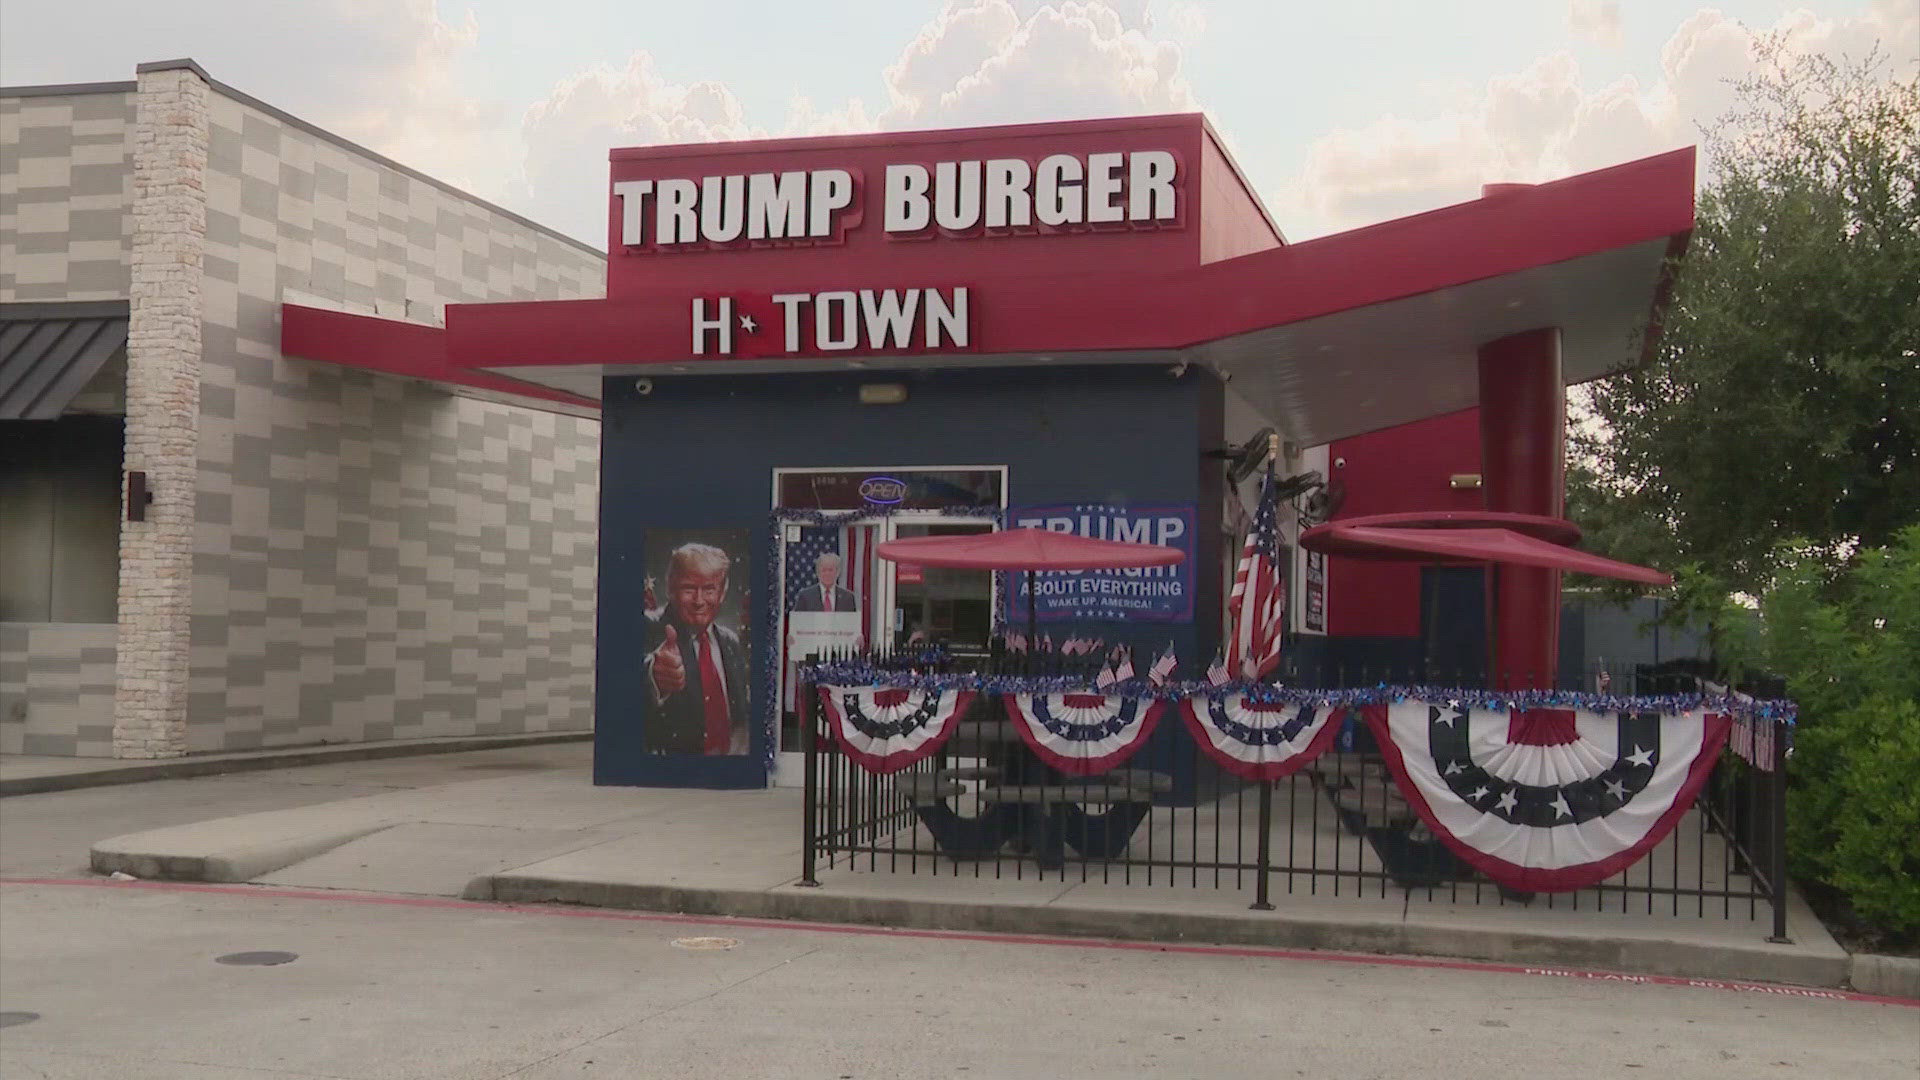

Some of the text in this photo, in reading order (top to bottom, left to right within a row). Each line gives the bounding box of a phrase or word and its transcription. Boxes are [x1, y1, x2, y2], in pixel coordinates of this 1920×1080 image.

[614, 150, 1177, 246] TRUMP BURGER
[691, 287, 969, 355] H TOWN
[858, 482, 908, 497] OPEN
[1020, 579, 1182, 596] ABOUT EVERYTHING
[1048, 598, 1079, 607] WAKE
[1100, 598, 1152, 609] AMERICA!
[1689, 980, 1724, 989] NO
[1732, 984, 1847, 999] PARKING
